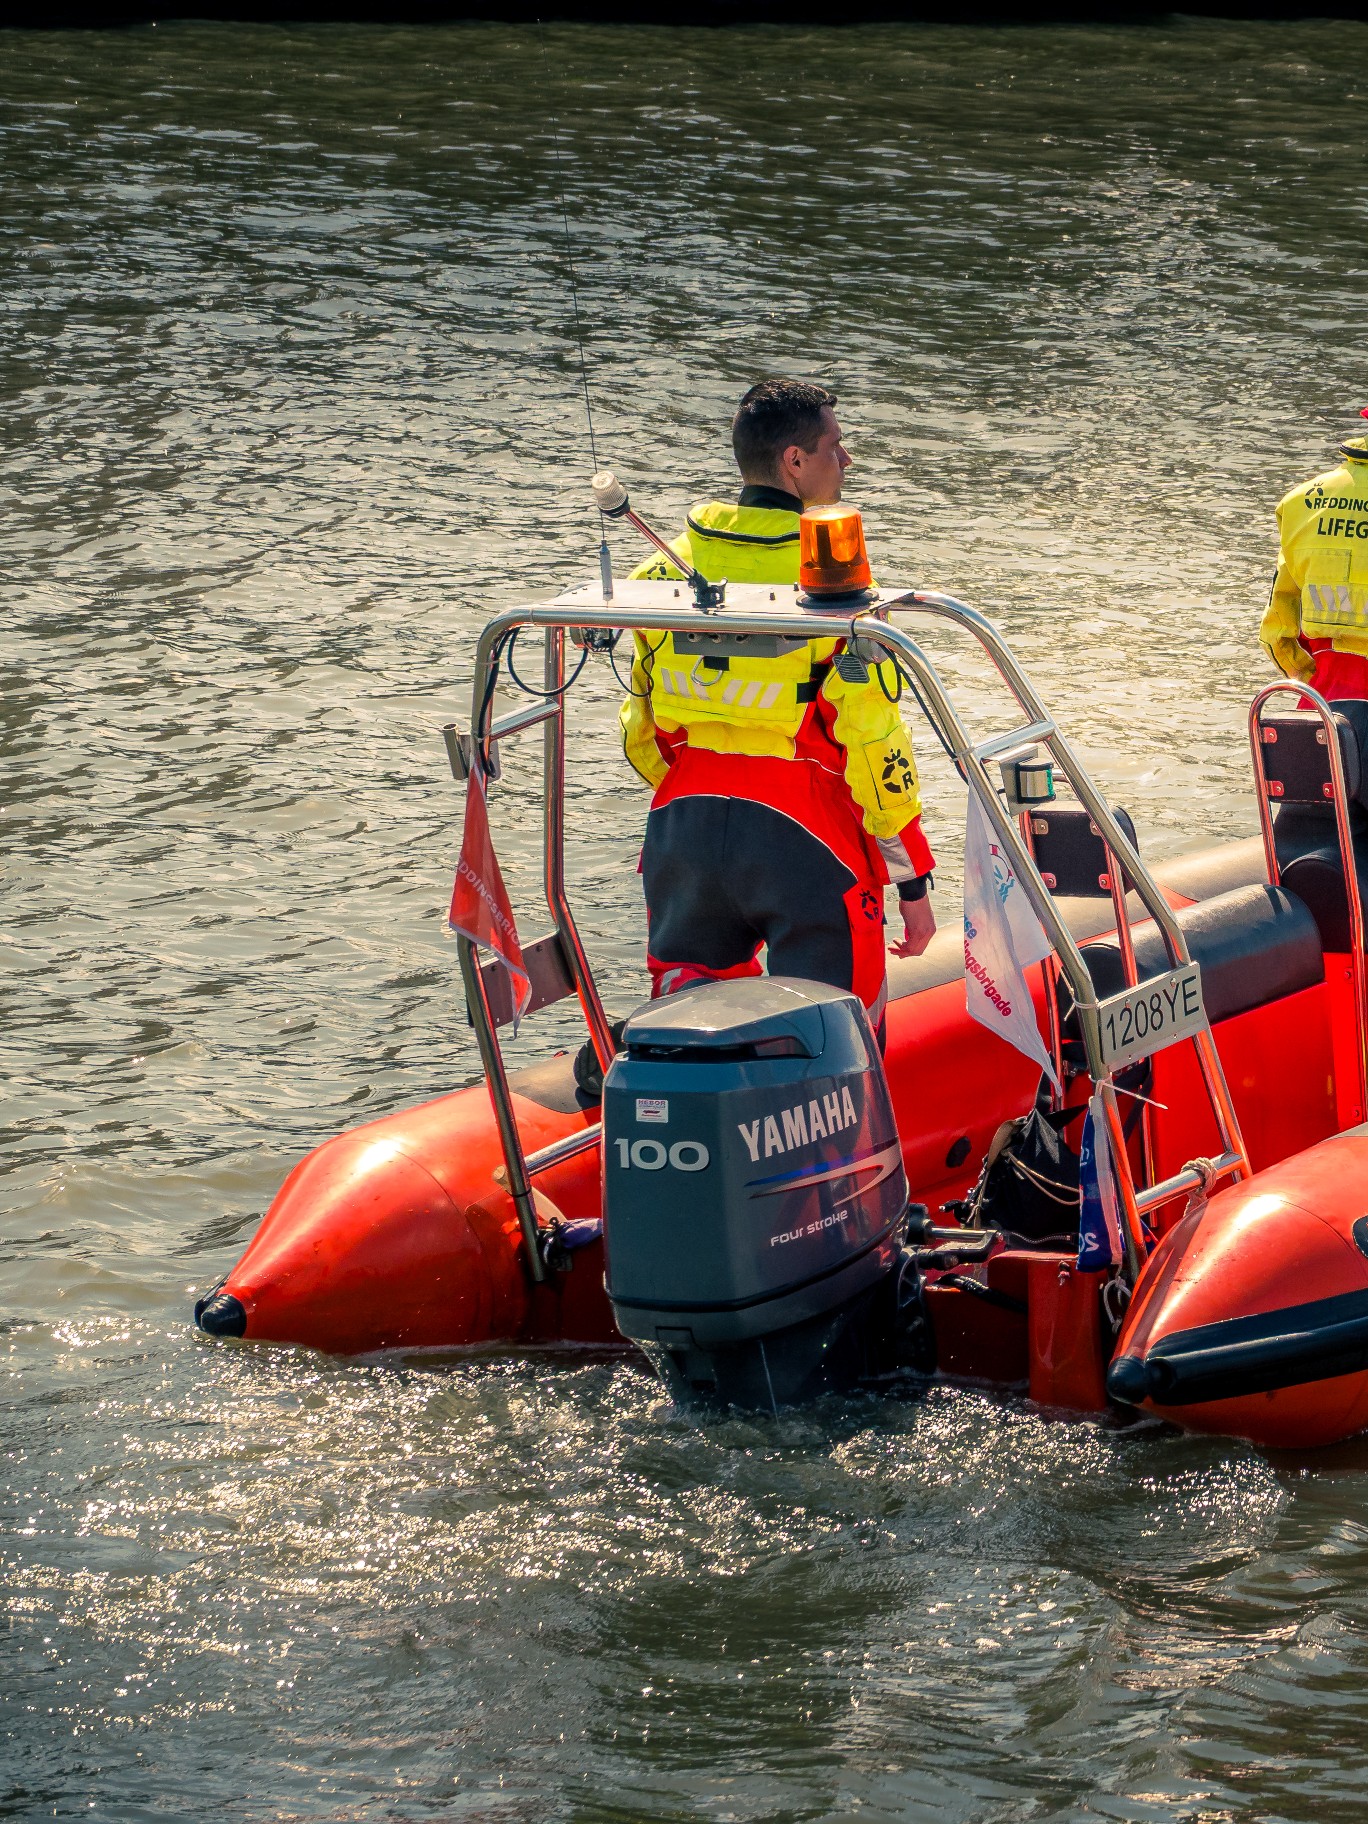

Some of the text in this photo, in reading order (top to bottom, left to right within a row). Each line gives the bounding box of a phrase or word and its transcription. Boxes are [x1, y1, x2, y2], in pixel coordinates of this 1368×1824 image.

[902, 770, 914, 790] R
[1106, 974, 1200, 1051] 1208YE
[737, 1085, 858, 1162] YAMAHA
[613, 1138, 710, 1172] 100
